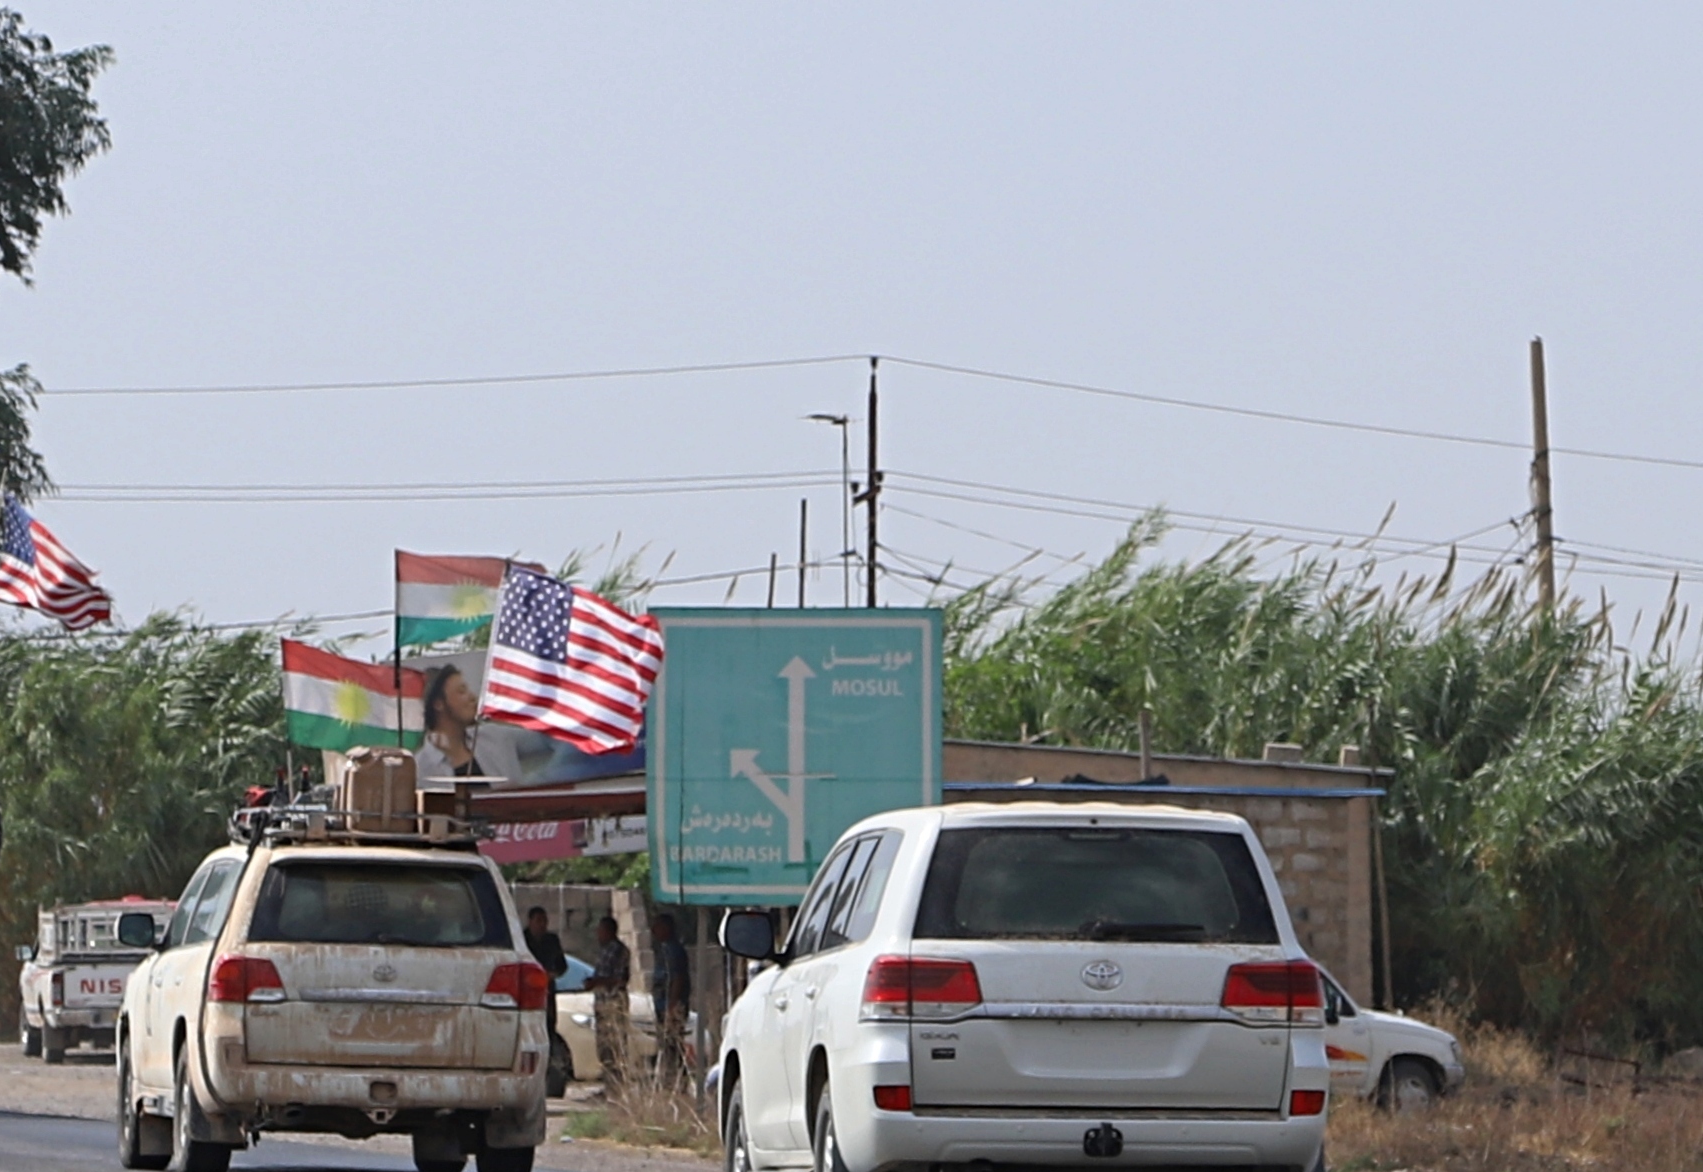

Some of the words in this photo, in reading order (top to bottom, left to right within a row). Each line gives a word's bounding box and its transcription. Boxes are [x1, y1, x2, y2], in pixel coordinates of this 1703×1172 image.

[832, 679, 903, 697] MOSUL
[670, 846, 781, 862] BARDARASH
[80, 979, 123, 994] NIS
